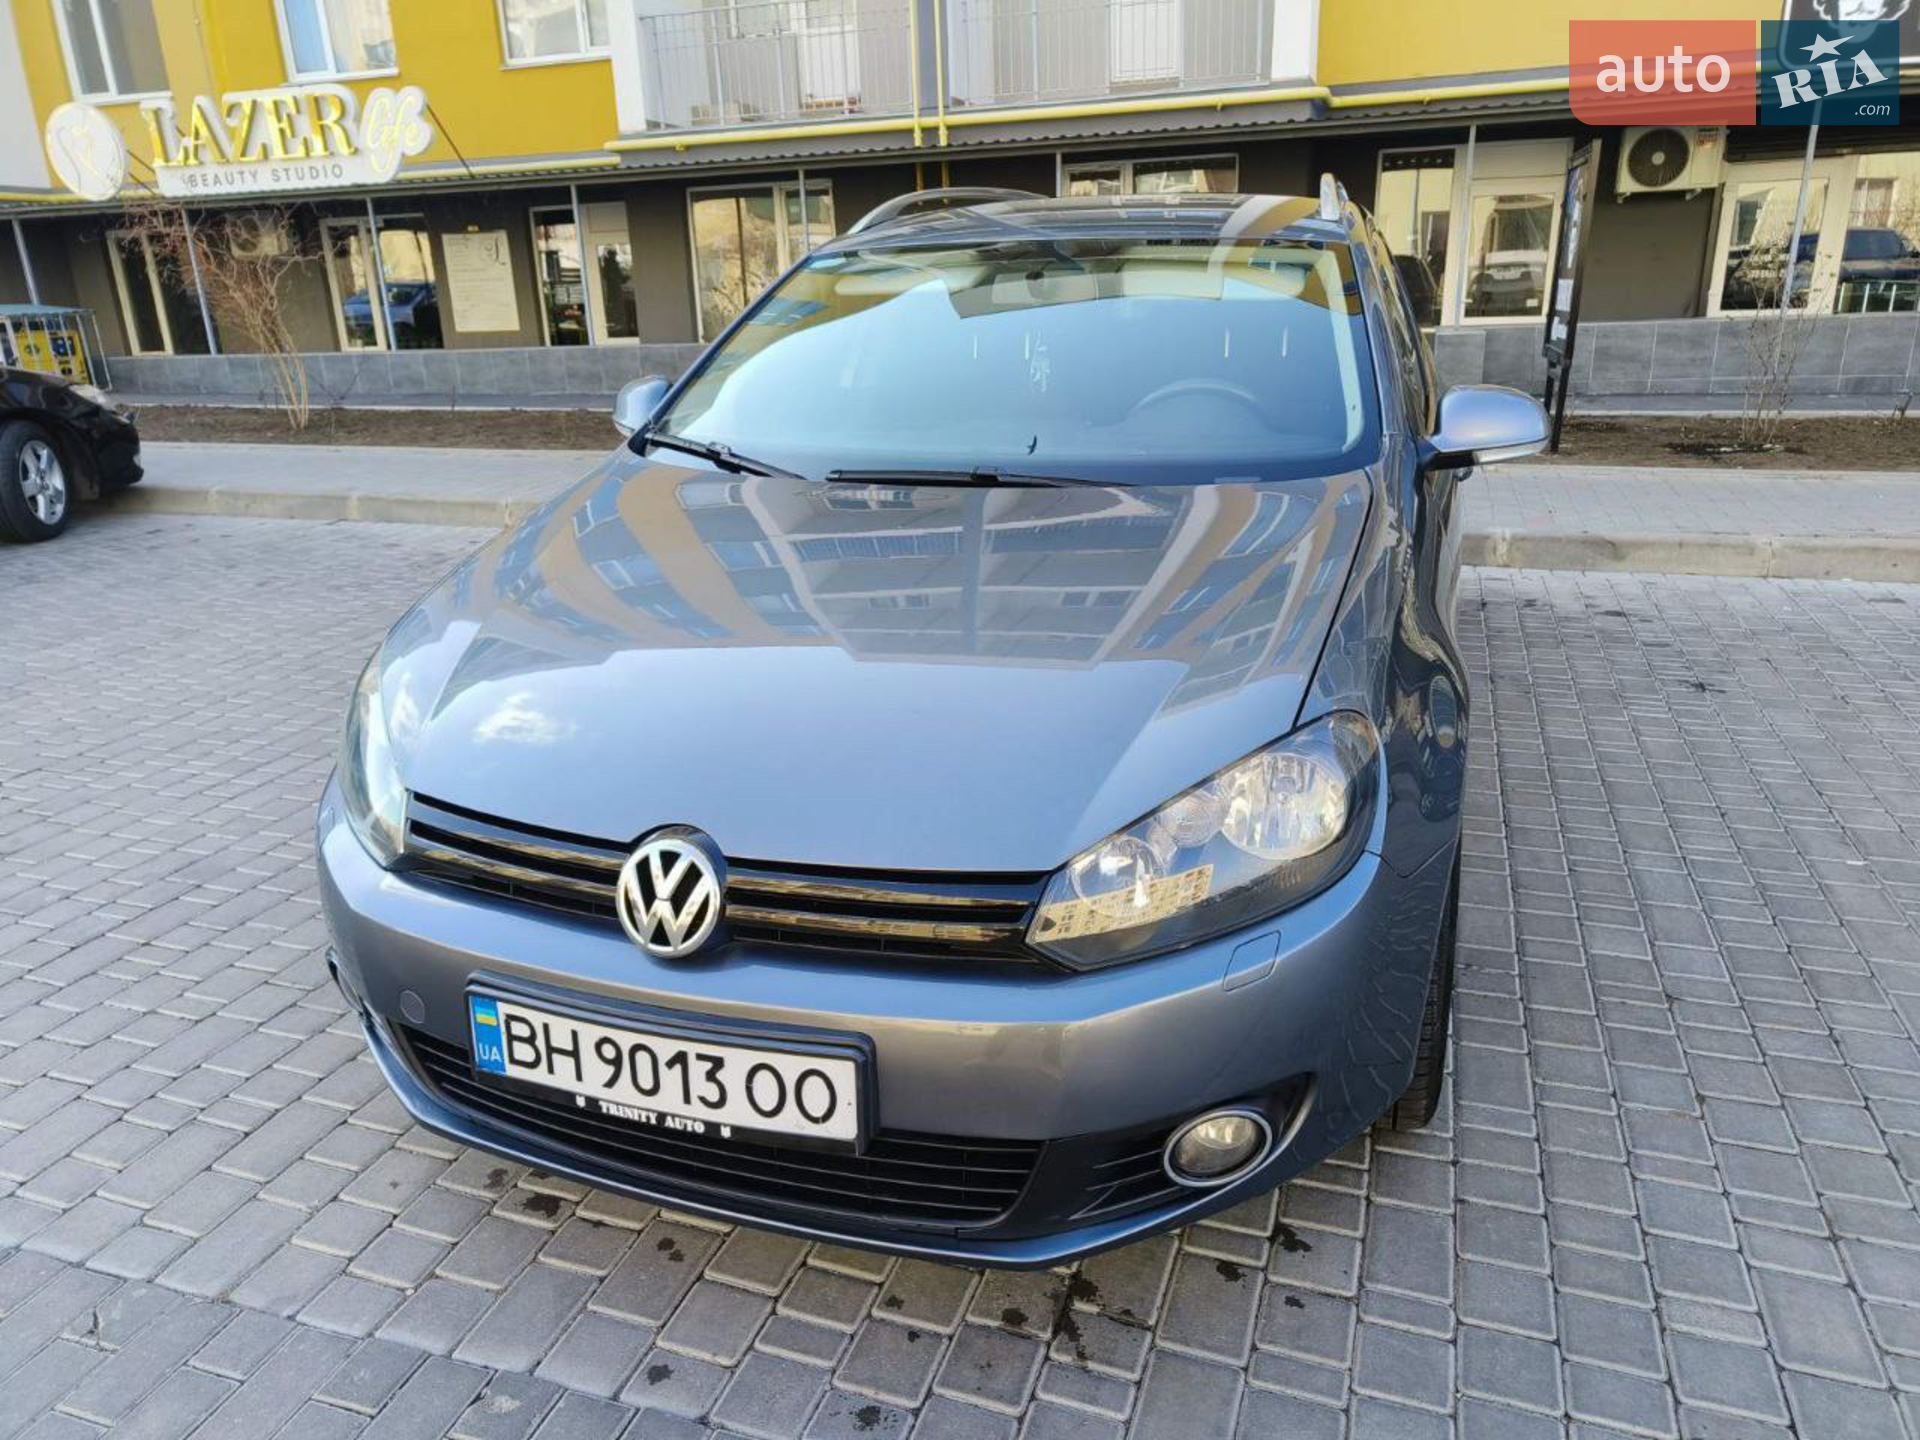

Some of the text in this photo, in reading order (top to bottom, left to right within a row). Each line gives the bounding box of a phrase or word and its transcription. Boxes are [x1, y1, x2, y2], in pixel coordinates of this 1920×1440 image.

[141, 92, 360, 168] LAZER
[188, 163, 344, 189] BEAUTY STUDIO
[478, 1041, 501, 1062] UA
[504, 1013, 584, 1082] BH
[594, 1035, 728, 1110] 9013
[598, 1100, 706, 1134] TRINITY AUTO
